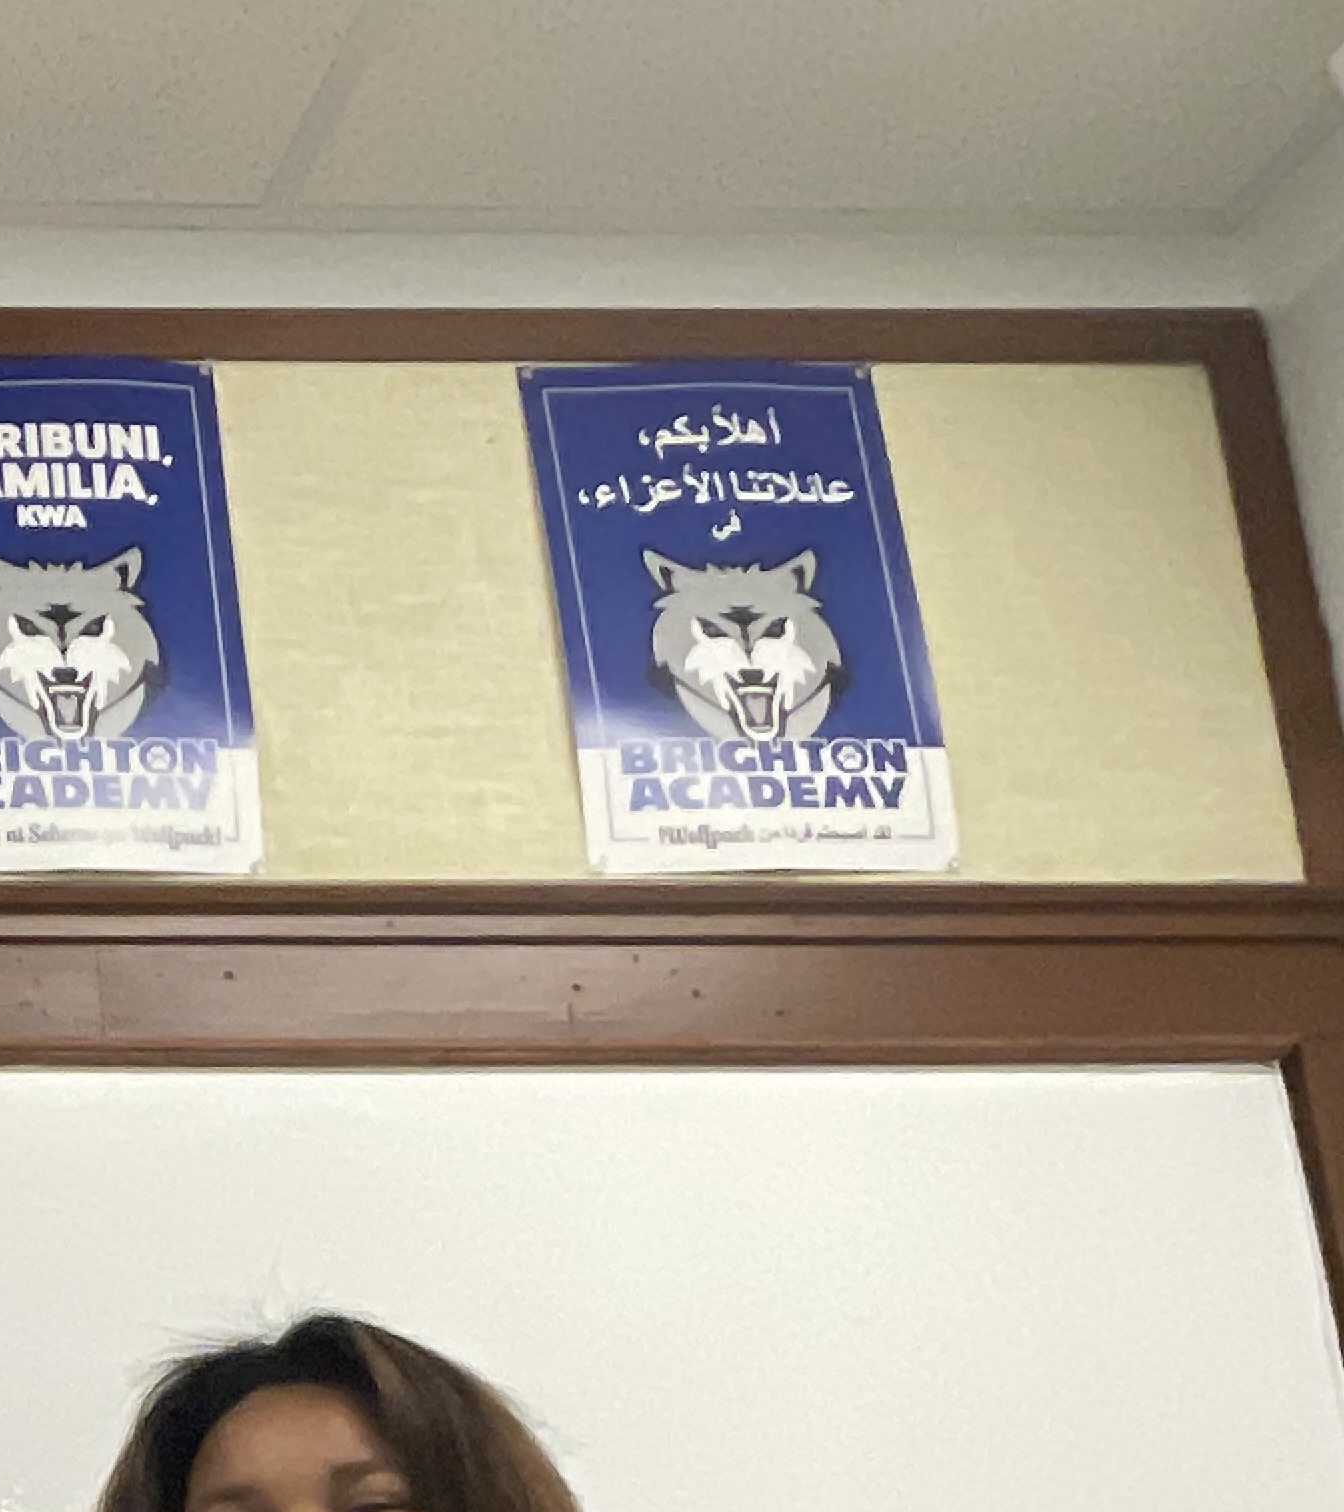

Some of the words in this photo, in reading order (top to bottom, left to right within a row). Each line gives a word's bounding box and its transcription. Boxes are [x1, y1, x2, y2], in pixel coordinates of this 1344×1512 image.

[16, 505, 87, 529] KWA
[620, 737, 908, 775] BRIGHTON
[629, 774, 908, 812] ACADEMY
